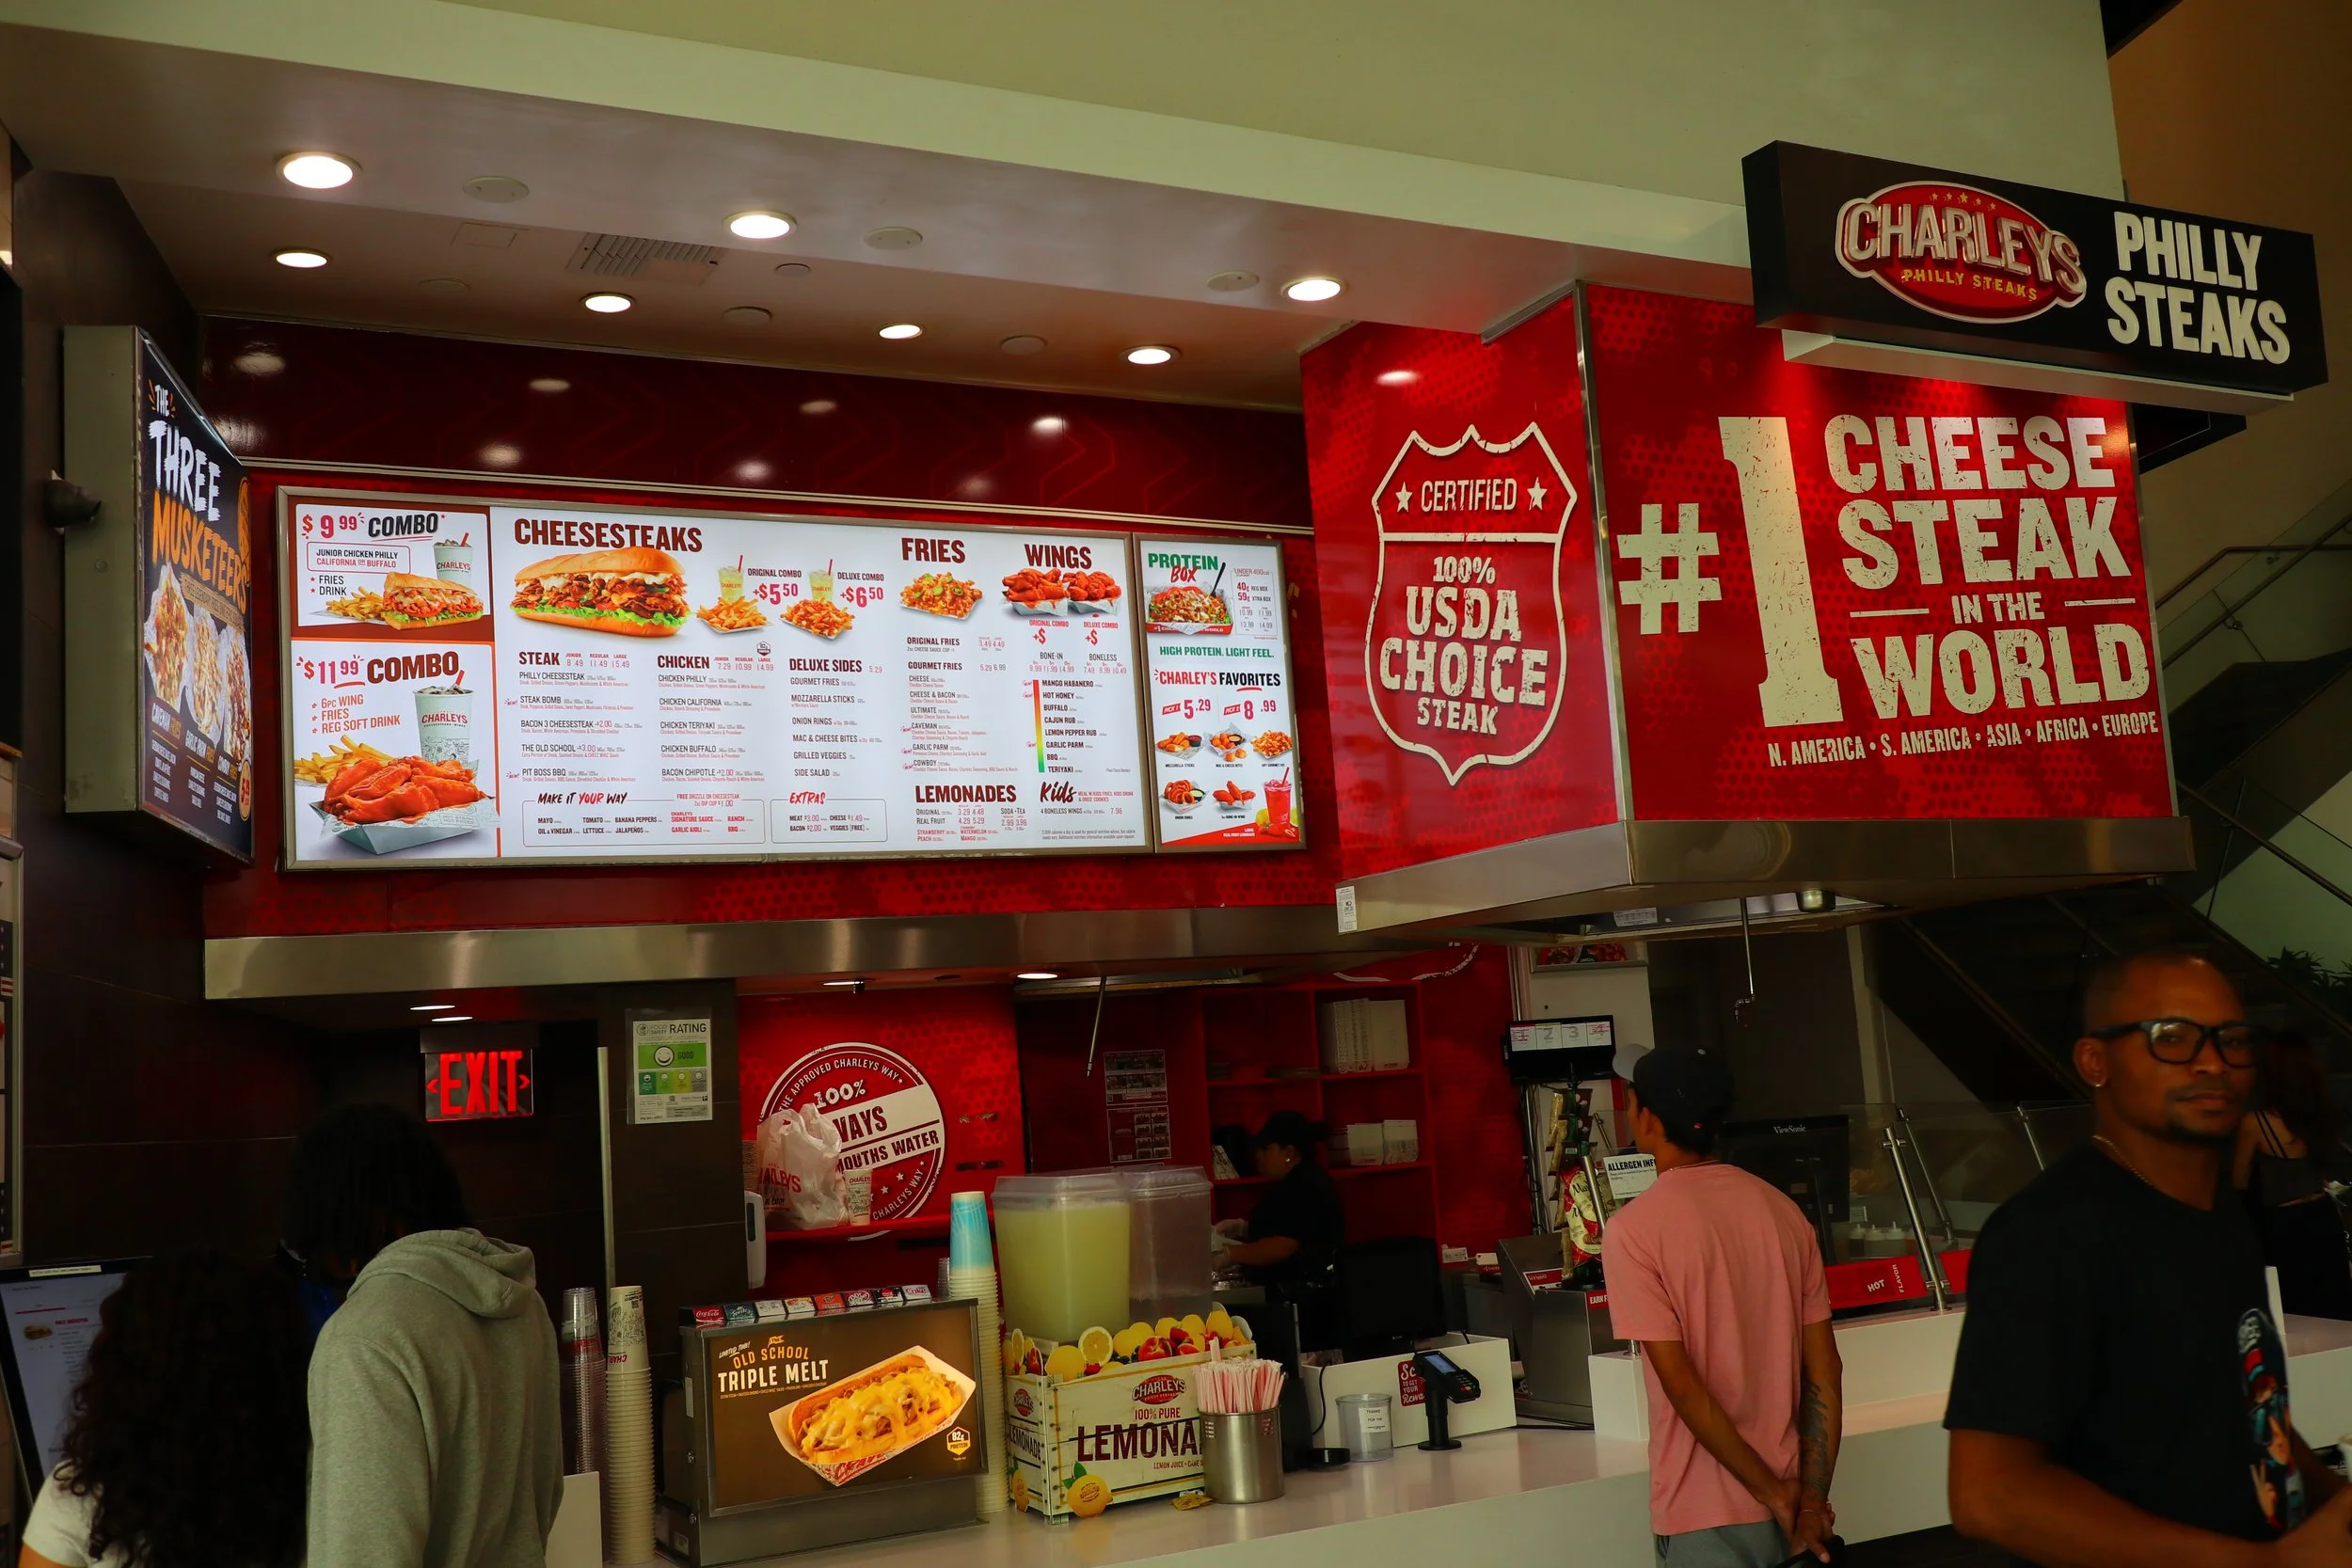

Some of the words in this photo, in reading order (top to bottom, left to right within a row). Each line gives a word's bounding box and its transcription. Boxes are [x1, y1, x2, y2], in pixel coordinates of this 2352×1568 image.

[1844, 201, 2086, 294] CHARLEYS
[2113, 212, 2262, 291] PHILLY
[1902, 269, 1963, 285] PHILLY
[1973, 275, 2038, 302] STEAKS
[2106, 277, 2290, 364] STEAKS
[155, 385, 170, 417] THE
[1824, 415, 2115, 491] CHEESE
[149, 420, 221, 521] THREE
[1421, 478, 1518, 512] CERTIFIED
[368, 513, 438, 537] COMBO
[514, 518, 702, 553] CHEESESTEAKS
[151, 488, 249, 614] MUSKETEERS
[316, 548, 342, 558] JUNIOR
[343, 549, 373, 559] CHICKEN
[374, 550, 398, 559] PHILLY
[901, 538, 965, 563] FRIES
[1838, 497, 2132, 590] STEAK
[316, 558, 357, 566] CALIFORNIA
[366, 560, 397, 568] BUFFALO
[1025, 544, 1091, 569] WINGS
[1148, 553, 1218, 570] PROTEIN
[318, 575, 344, 585] FRIES
[748, 568, 776, 578] ORIGINAL
[778, 569, 802, 579] COMBO
[837, 571, 861, 580] DELUXE
[862, 572, 884, 581] COMBO
[1170, 565, 1198, 582] BOX
[1433, 556, 1496, 584] 100%
[319, 585, 347, 595] DRINK
[1406, 586, 1521, 641] USDA
[1951, 594, 1980, 624] IN
[1992, 592, 2044, 622] THE
[907, 637, 939, 645] ORIGINAL
[1160, 646, 1182, 656] HIGH
[1184, 647, 1223, 656] PROTEIN.
[1226, 647, 1250, 657] LIGHT
[1252, 649, 1274, 657] FEEL.
[367, 651, 459, 685] COMBO
[518, 651, 561, 666] STEAK
[658, 655, 709, 669] CHICKEN
[789, 658, 829, 671] DELUXE
[832, 659, 862, 673] SIDES
[908, 661, 941, 670] GOURMET
[542, 672, 584, 680] CHEESESTEAK
[1160, 671, 1216, 685] CHARLEY'S
[1219, 673, 1280, 686] FAVORITES
[1379, 638, 1549, 706] CHOICE
[1850, 623, 2151, 720] WORLD
[339, 694, 364, 706] WING
[791, 694, 832, 703] MOZZARELLA
[321, 708, 349, 721] FRIES
[322, 722, 341, 734] REG
[343, 719, 368, 732] SOFT
[370, 715, 400, 729] DRINK
[421, 713, 468, 723] CHARLEYS
[1417, 697, 1498, 735] STEAK
[549, 744, 576, 752] SCHOOL
[1768, 743, 1787, 767] N.
[1792, 736, 1866, 765] AMERICA
[1881, 733, 1898, 756] S.
[1901, 725, 1972, 754] AMERICA
[1987, 722, 2022, 746] ASIA
[2037, 718, 2090, 743] AFRICA
[2102, 712, 2158, 737] EUROPE
[537, 792, 564, 804] MAKE
[579, 792, 604, 804] YOUR
[606, 792, 628, 804] WAY
[915, 784, 1016, 802] LEMONADES
[1040, 781, 1076, 803] Kids
[670, 1023, 707, 1034] RATING
[439, 1051, 522, 1116] EXIT
[779, 1096, 793, 1113] THE
[790, 1063, 832, 1096] APPROVED
[834, 1058, 881, 1071] CHARLEYS
[882, 1065, 899, 1081] WAY
[814, 1079, 866, 1109] 100%
[1772, 1124, 1806, 1135] ViewSonic
[891, 1130, 939, 1157] WATER
[1608, 1161, 1643, 1171] ALLERGEN
[1644, 1158, 1656, 1167] INF
[872, 1188, 911, 1221] CHARLEYS
[911, 1168, 925, 1188] WAY
[1867, 1279, 1885, 1292] HOT
[1892, 1264, 1905, 1293] FLAVOR
[733, 1352, 755, 1369] OLD
[761, 1346, 809, 1361] SCHOOL
[718, 1366, 778, 1392] TRIPLE
[786, 1360, 828, 1384] MELT
[1132, 1379, 1185, 1401] CHARLEYS
[1136, 1408, 1156, 1419] 100%
[1159, 1407, 1181, 1418] PURE
[1009, 1426, 1041, 1460] LEMONADE
[1078, 1418, 1203, 1462] LEMONA
